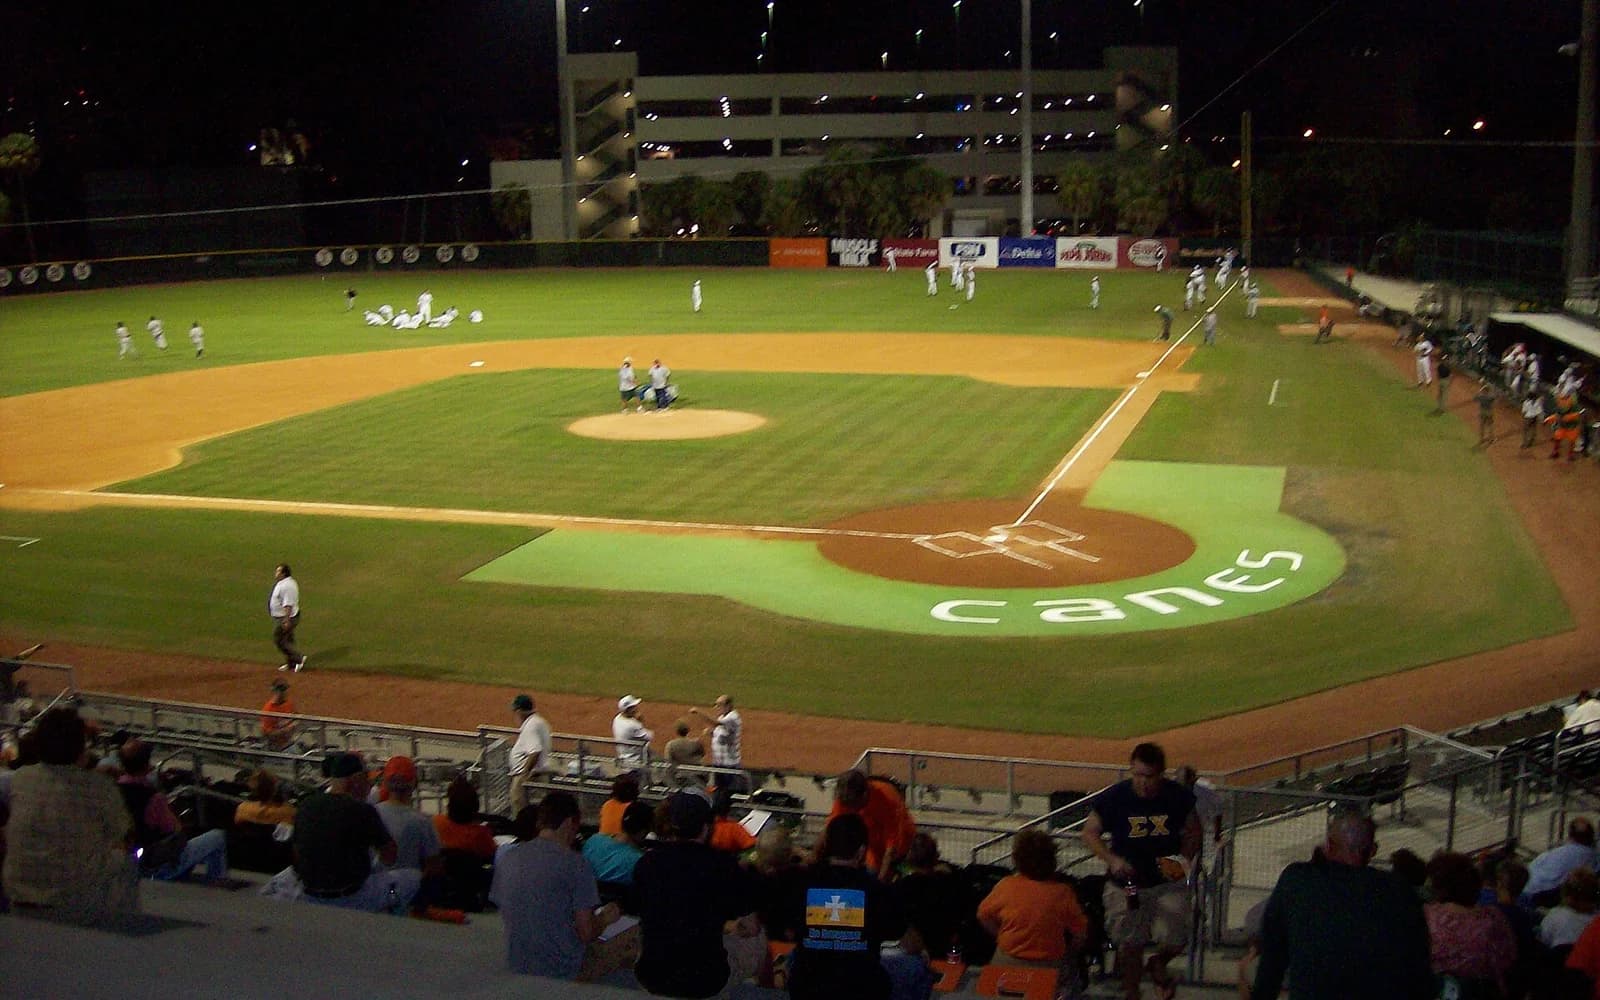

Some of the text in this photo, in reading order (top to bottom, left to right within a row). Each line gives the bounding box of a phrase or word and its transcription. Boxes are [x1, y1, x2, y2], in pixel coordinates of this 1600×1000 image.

[831, 238, 878, 254] MUSCLE
[915, 247, 938, 258] Farm
[1012, 247, 1042, 259] Delta
[839, 251, 870, 267] MILK
